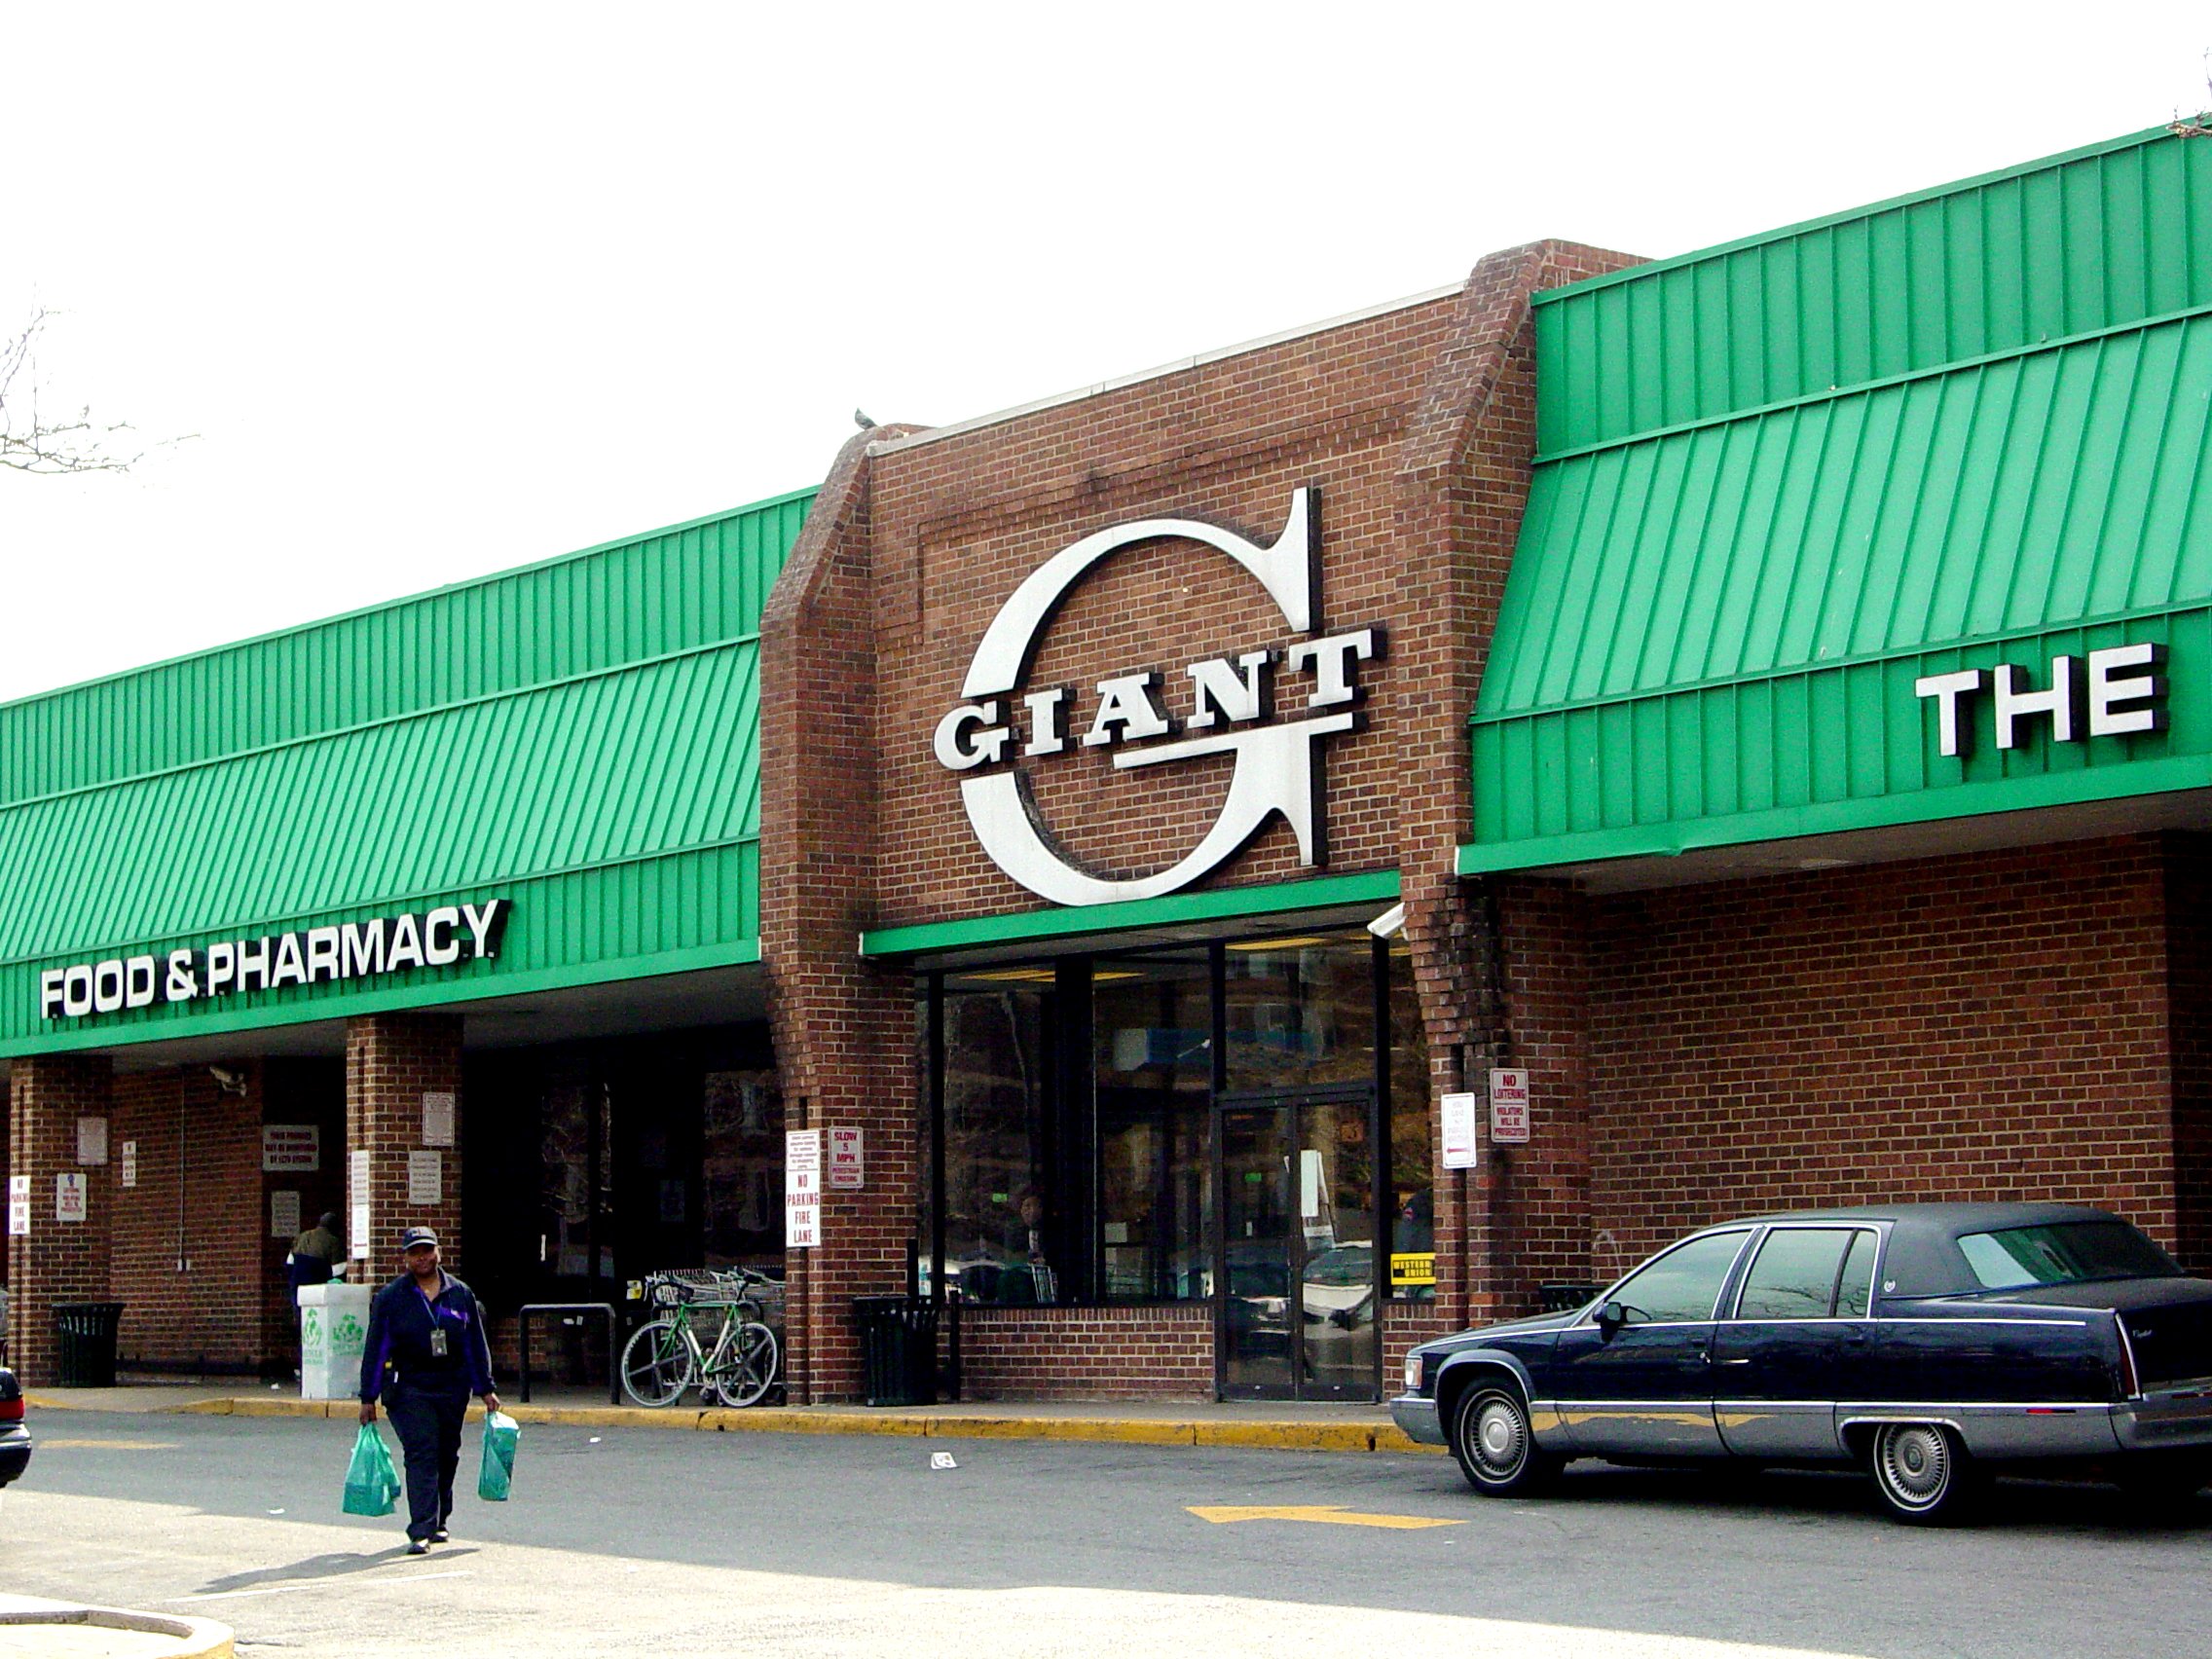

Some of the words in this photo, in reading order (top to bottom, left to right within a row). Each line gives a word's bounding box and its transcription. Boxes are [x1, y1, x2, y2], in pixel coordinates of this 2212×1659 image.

[933, 629, 1374, 770] GIANT
[1915, 643, 2154, 757] THE
[40, 954, 156, 1019] FOOD
[166, 949, 199, 1002] &
[207, 899, 500, 997] PHARMACY
[1503, 1075, 1516, 1087] NO
[1494, 1088, 1525, 1099] LOITERING
[834, 1131, 857, 1141] SLOW
[842, 1143, 849, 1152] 5
[836, 1154, 855, 1162] MPH
[797, 1174, 808, 1188] NO
[787, 1192, 819, 1208] PARKING
[794, 1210, 811, 1225] FIRE
[793, 1229, 813, 1243] LANE
